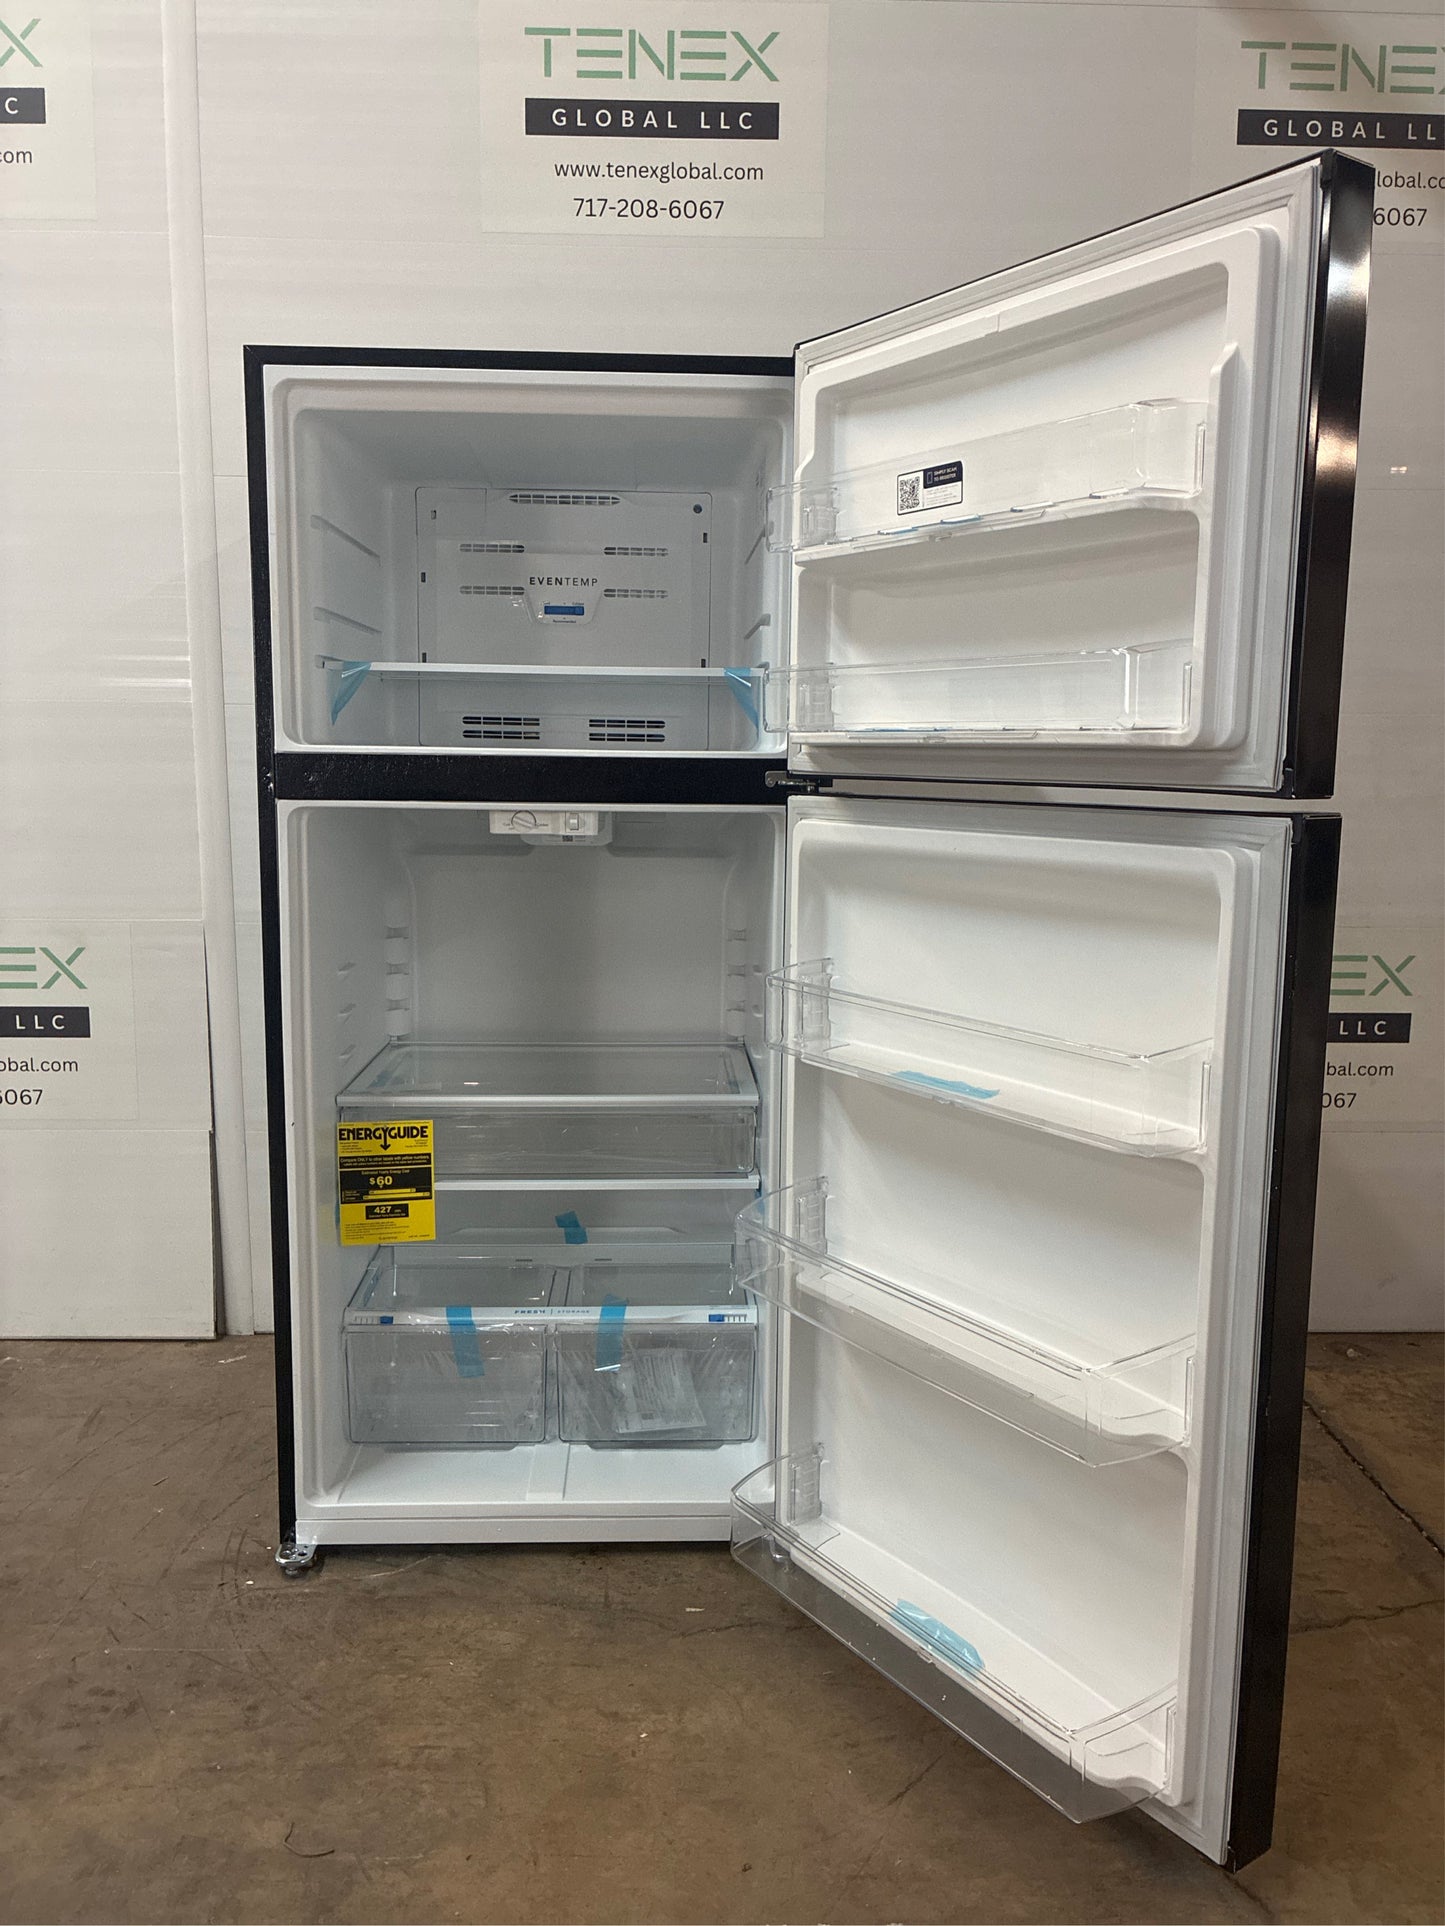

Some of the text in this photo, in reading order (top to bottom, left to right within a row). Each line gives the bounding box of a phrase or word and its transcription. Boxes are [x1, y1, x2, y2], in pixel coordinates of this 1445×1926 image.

[524, 27, 780, 82] TENEX
[1241, 41, 1445, 94] TENE
[552, 108, 753, 130] GLOBAL LLC
[1263, 119, 1437, 141] GLOBAL LL
[0, 150, 33, 164] om
[554, 162, 764, 184] www.tenexglobal.com
[573, 198, 725, 220] 717-208-6067
[529, 576, 598, 587] EVENTEMP
[15, 1014, 66, 1030] LLC
[1339, 1020, 1388, 1036] LLC
[338, 1126, 428, 1141] ENERGYGUIDE
[374, 1205, 392, 1214] 427
